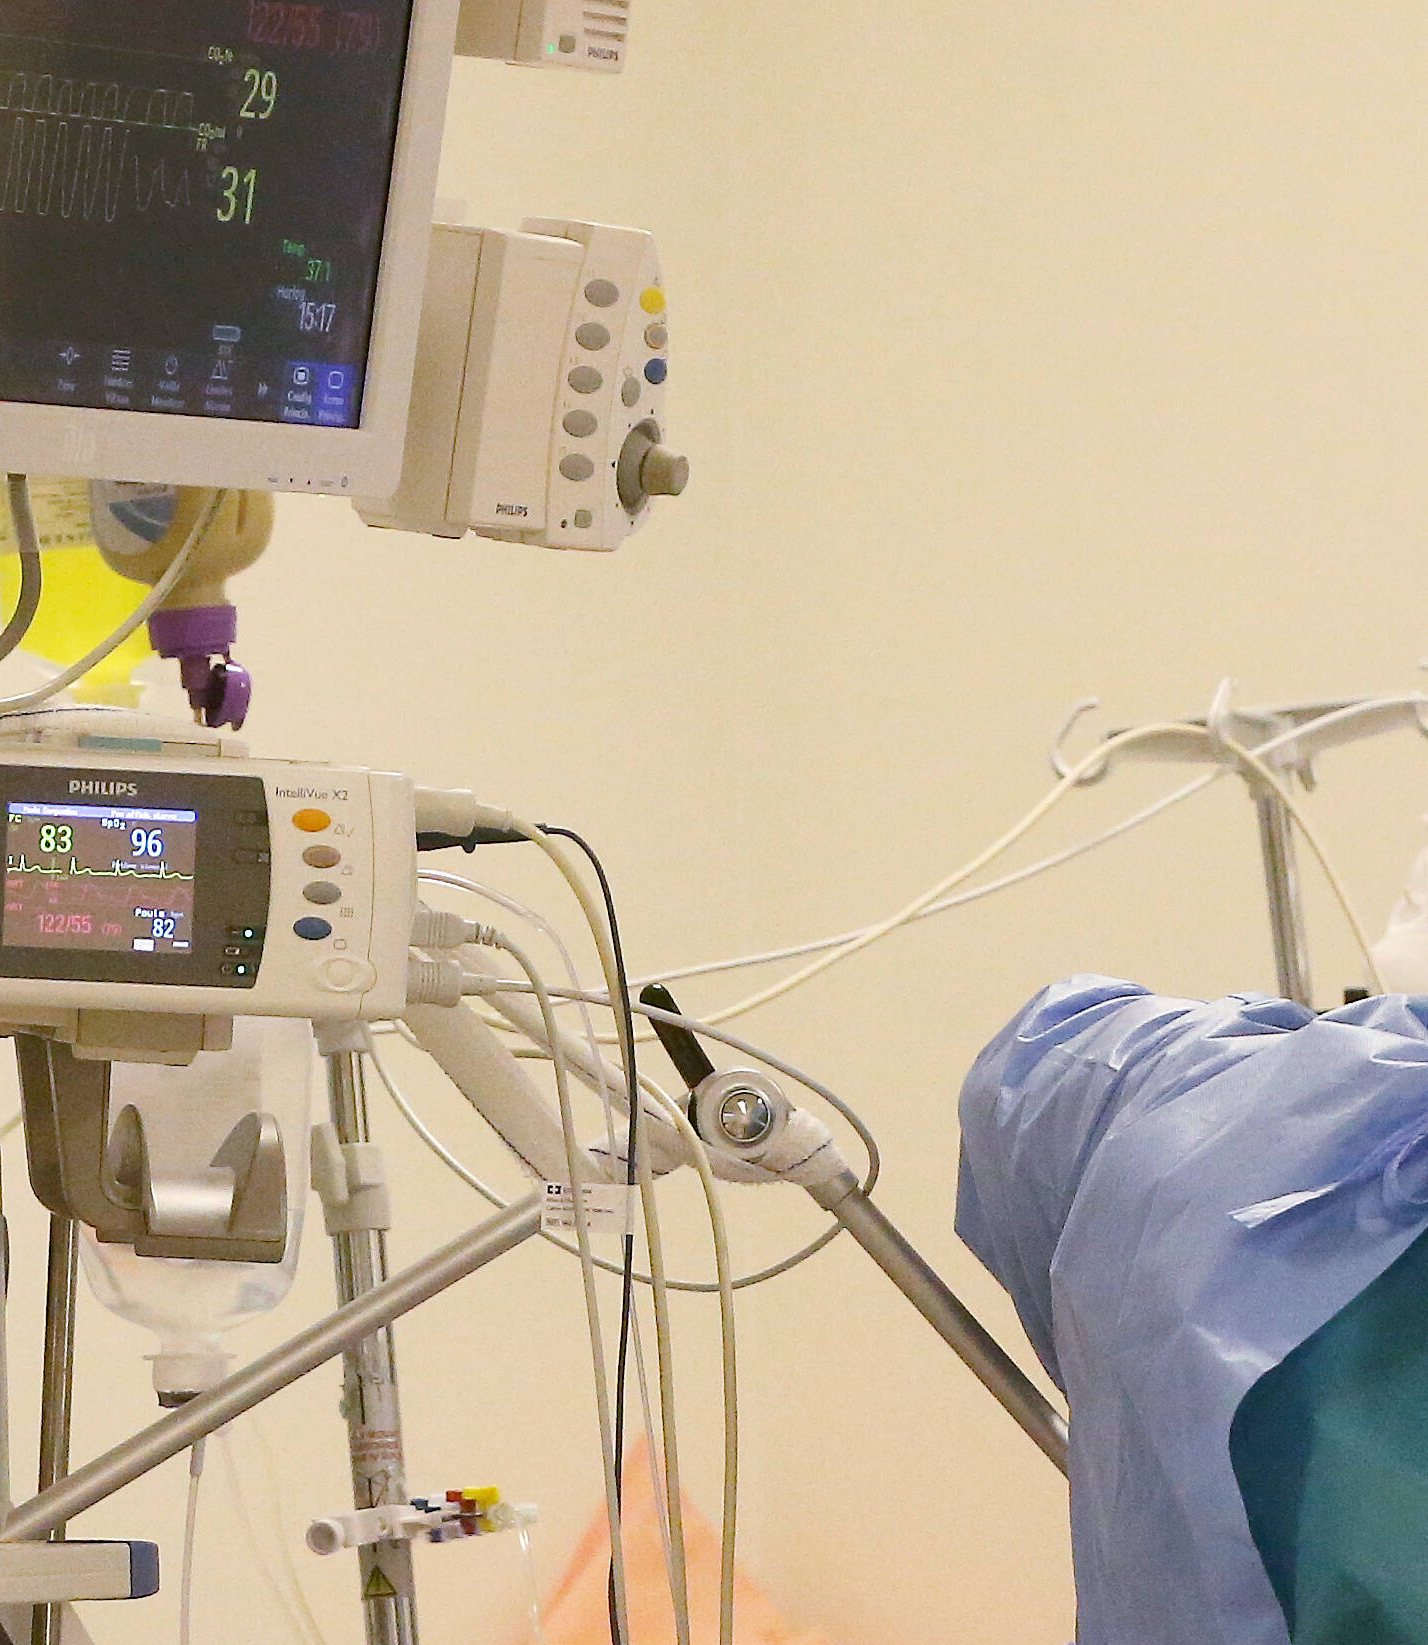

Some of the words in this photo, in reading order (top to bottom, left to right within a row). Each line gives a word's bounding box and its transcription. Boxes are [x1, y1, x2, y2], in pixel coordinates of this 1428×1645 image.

[587, 47, 619, 61] PHILIPS
[239, 68, 277, 119] 29
[216, 165, 257, 224] 31
[495, 502, 529, 518] PHILIPS
[68, 779, 139, 797] PHILIPS
[332, 789, 349, 801] X2
[39, 825, 73, 853] 83
[130, 829, 164, 857] 96
[37, 913, 93, 935] 122/55
[152, 919, 175, 940] 82
